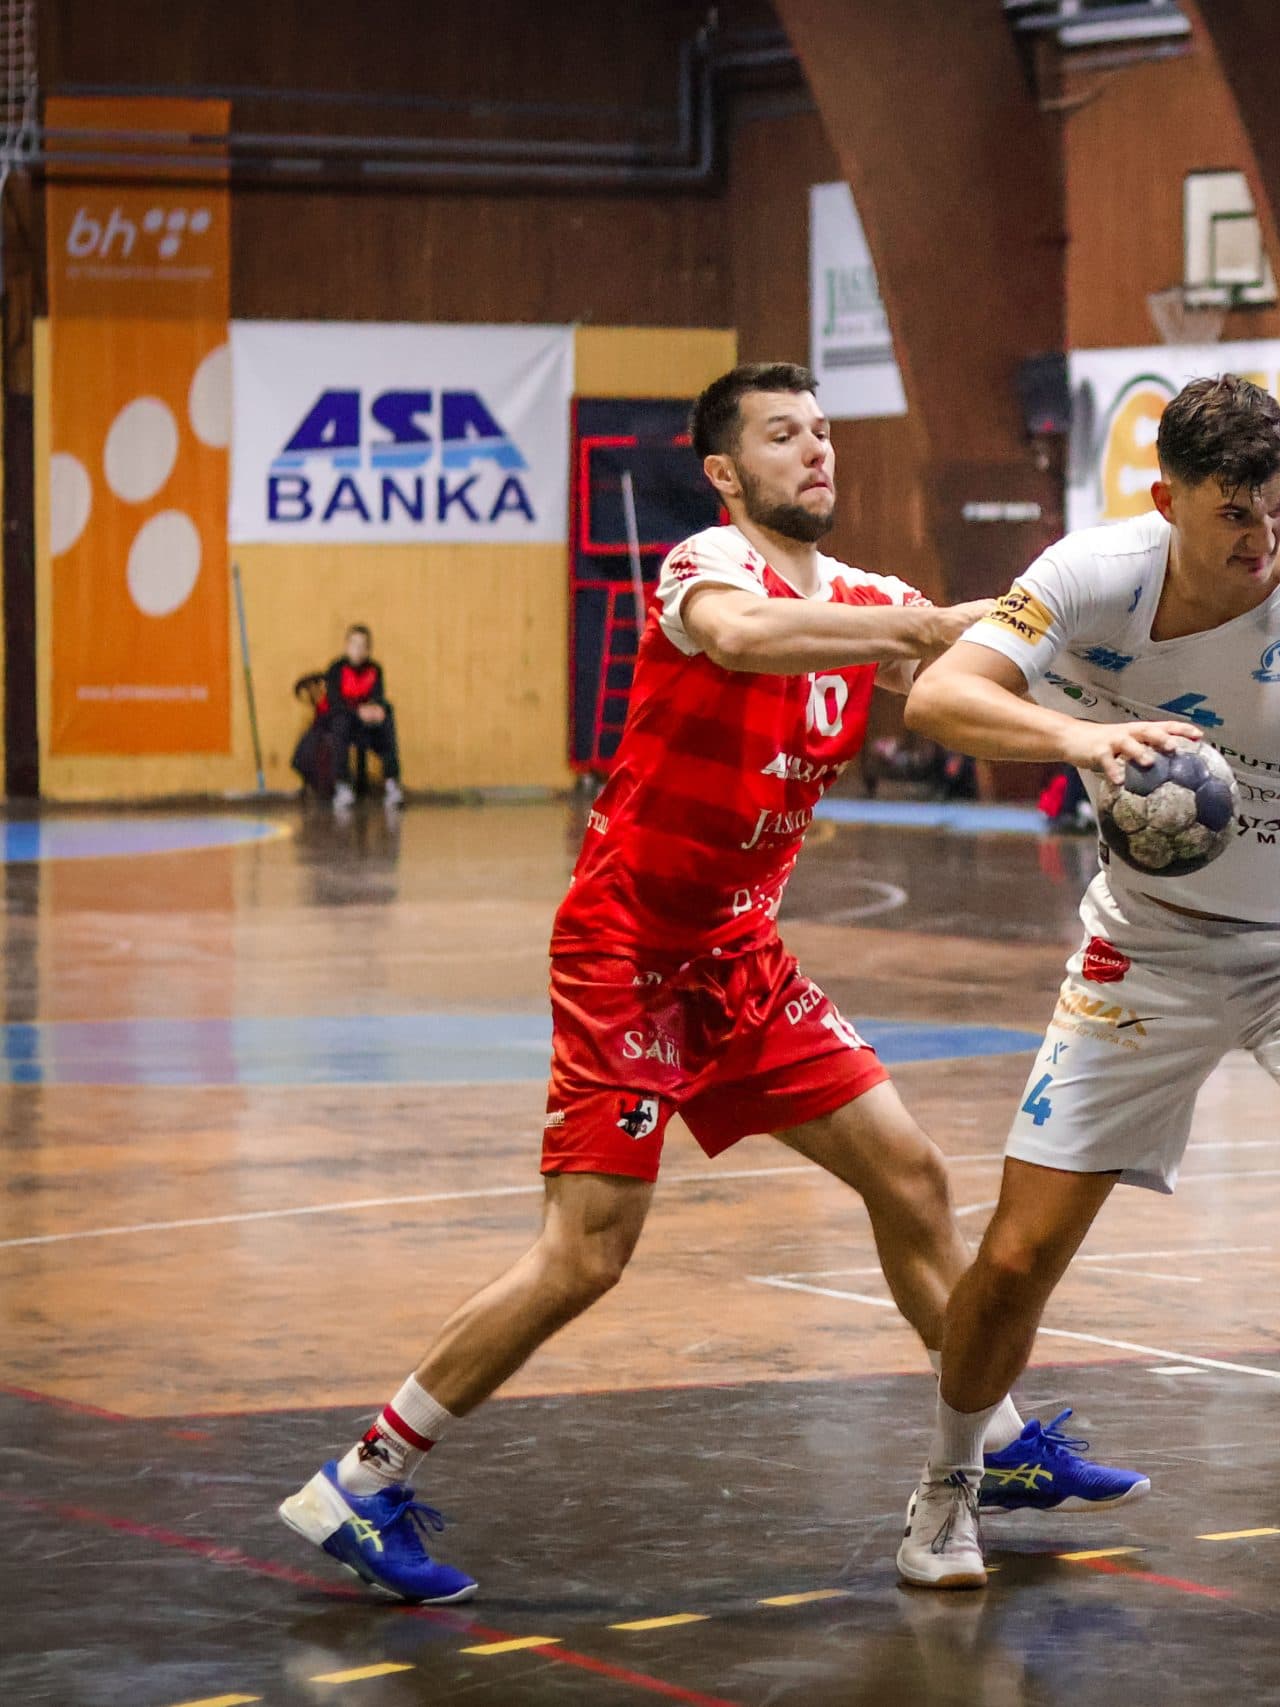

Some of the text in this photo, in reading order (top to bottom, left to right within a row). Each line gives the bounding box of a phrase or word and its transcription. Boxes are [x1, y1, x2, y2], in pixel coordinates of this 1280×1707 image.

[270, 391, 529, 469] ASA
[268, 473, 536, 523] BANKA
[1022, 1073, 1053, 1126] 4
